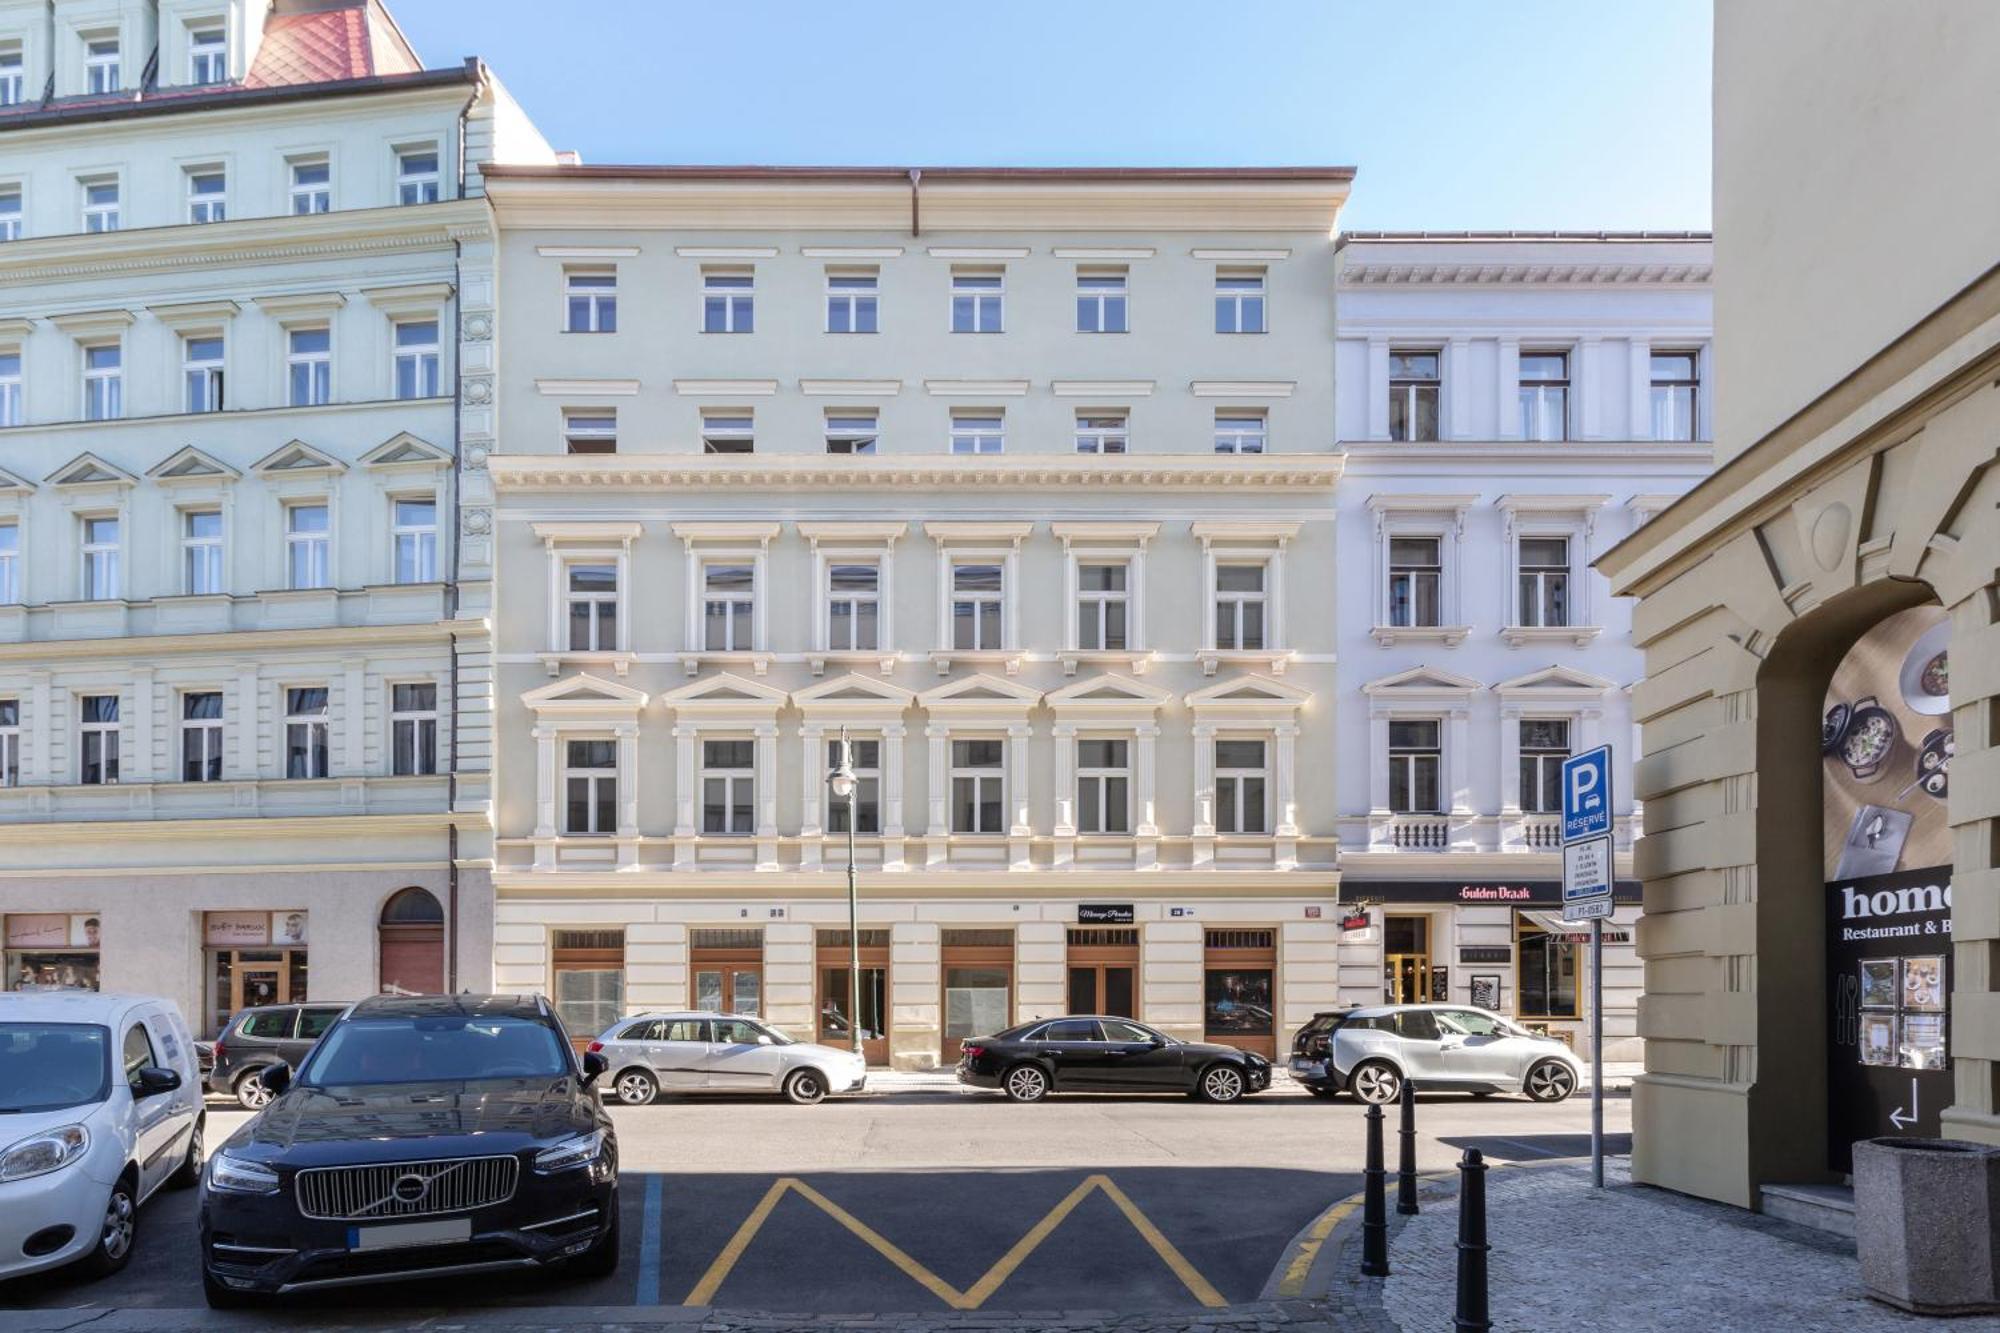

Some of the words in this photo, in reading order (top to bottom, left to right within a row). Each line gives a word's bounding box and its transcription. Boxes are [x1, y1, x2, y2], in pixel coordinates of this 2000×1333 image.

[1572, 763, 1599, 814] P
[1568, 812, 1605, 829] RÉSERVÉ
[1462, 886, 1497, 899] Gulden
[1498, 886, 1530, 899] Draak
[1843, 922, 1920, 941] Restaurant
[1924, 920, 1938, 934] &
